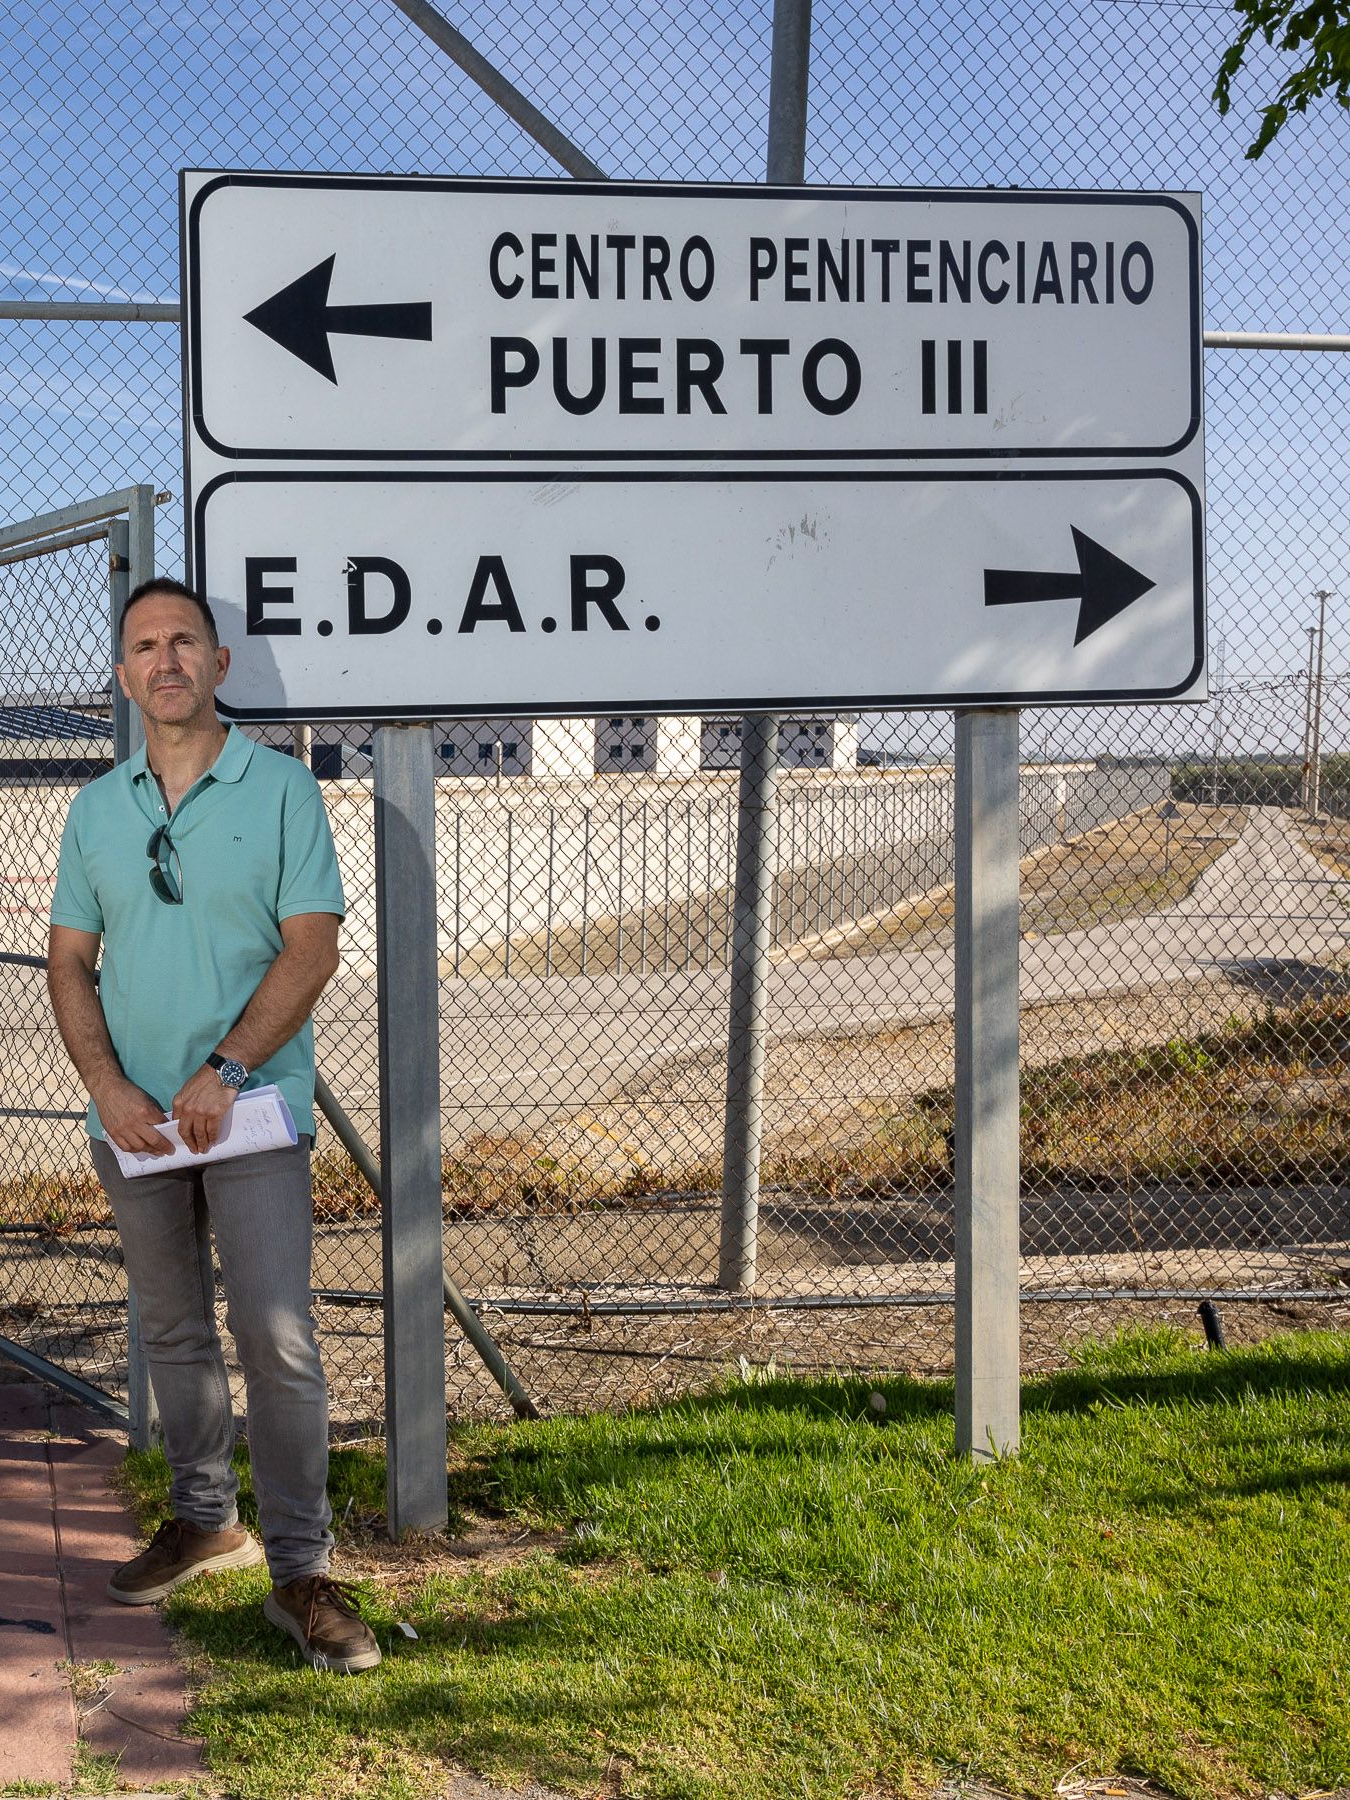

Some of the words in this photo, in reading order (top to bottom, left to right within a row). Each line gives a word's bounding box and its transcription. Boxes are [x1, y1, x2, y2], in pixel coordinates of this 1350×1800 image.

[489, 231, 715, 302] CENTRO
[749, 236, 1154, 306] PENITENCIARIO
[490, 336, 862, 416] PUERTO
[921, 339, 988, 415] III
[245, 554, 661, 637] E.D.A.R.
